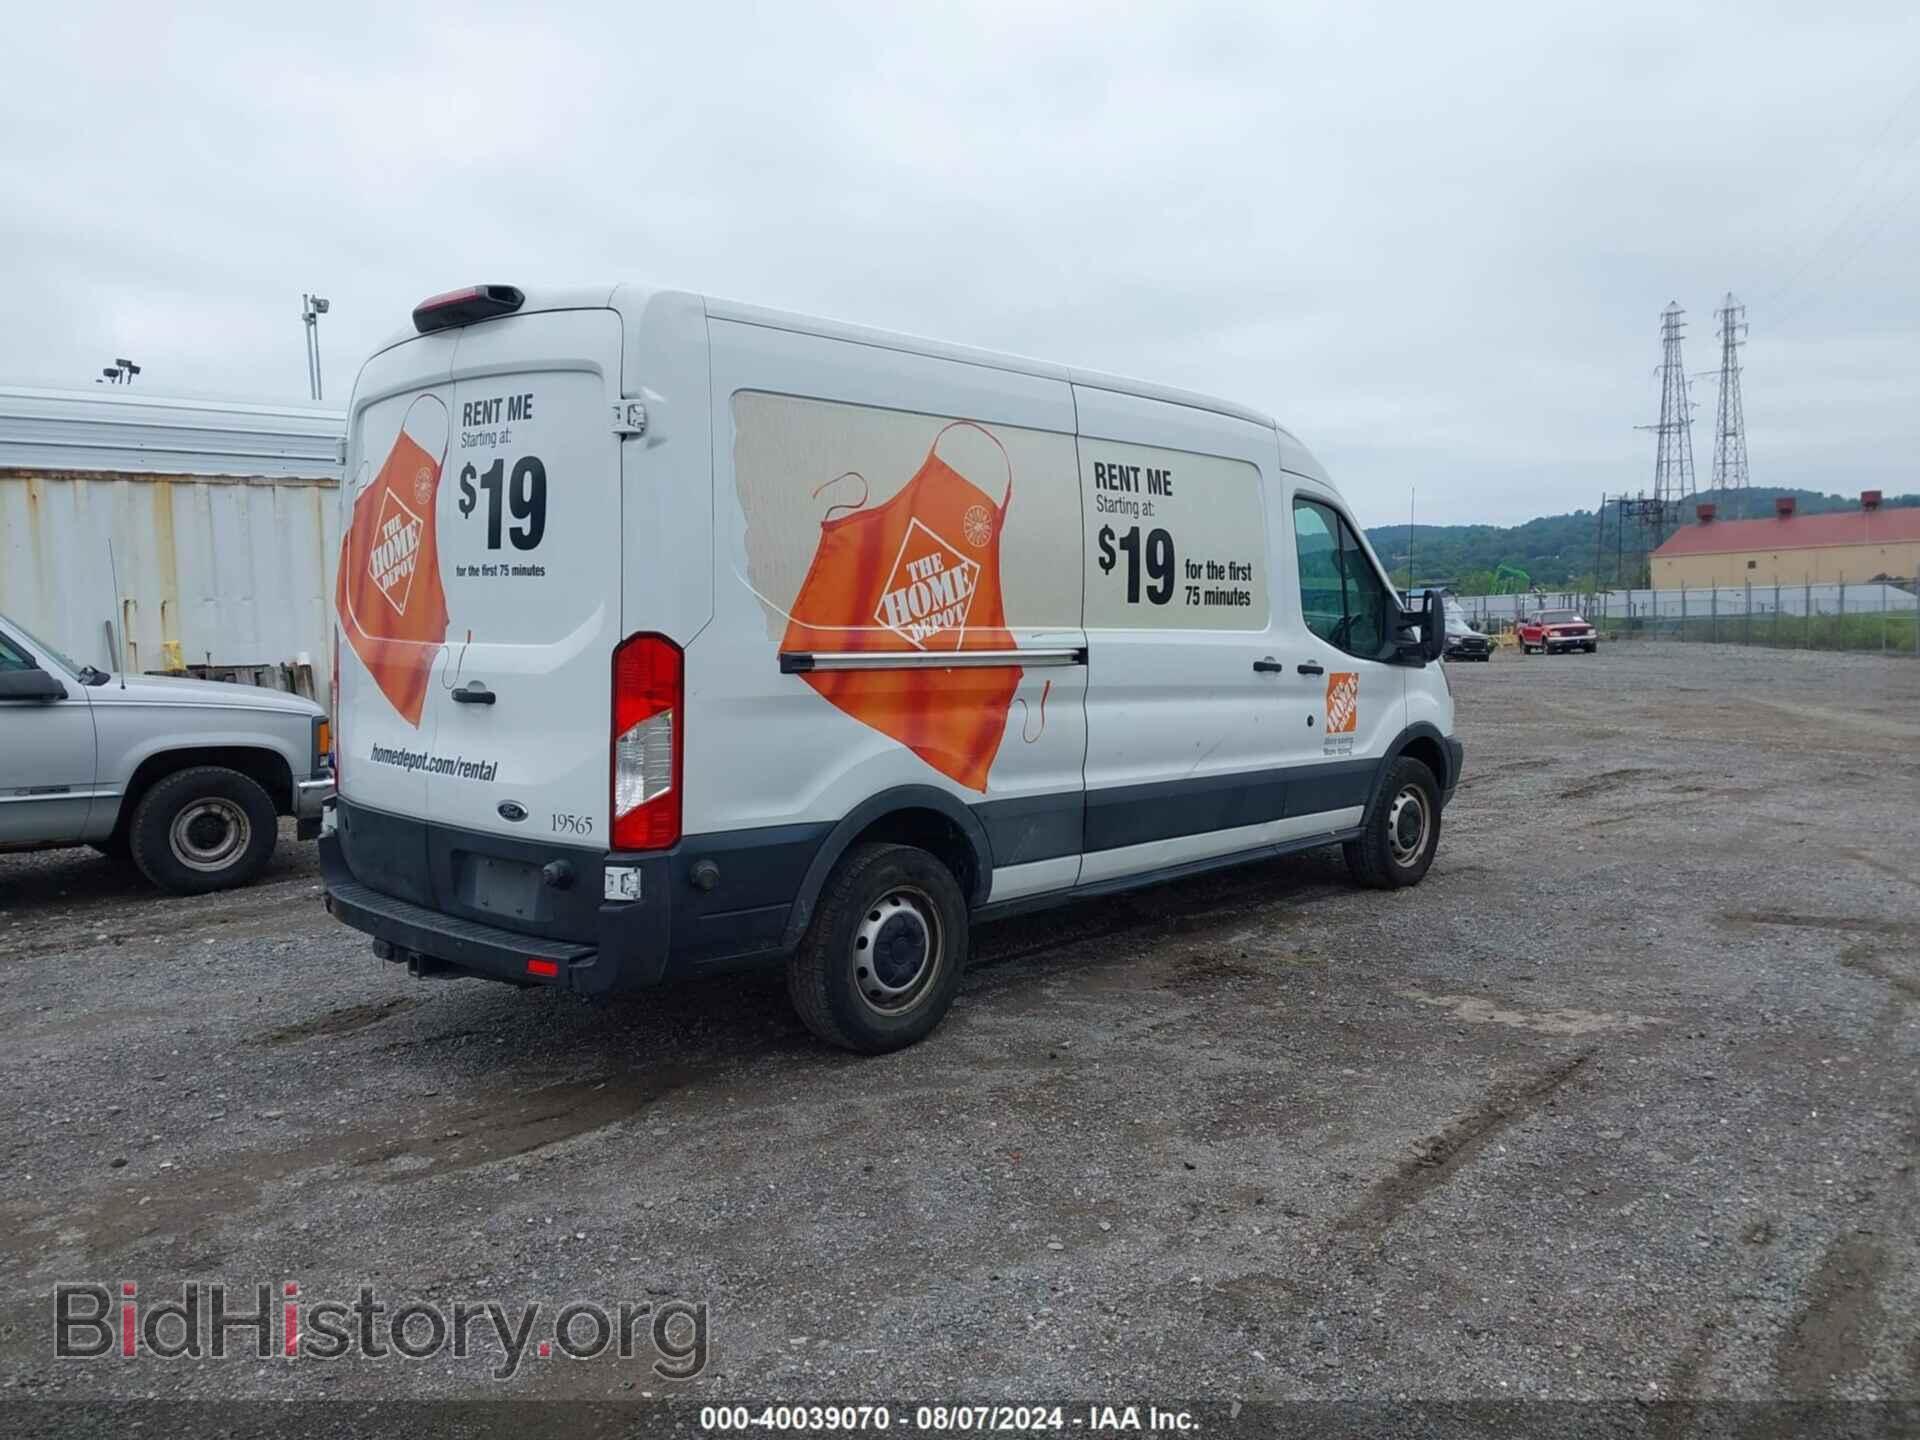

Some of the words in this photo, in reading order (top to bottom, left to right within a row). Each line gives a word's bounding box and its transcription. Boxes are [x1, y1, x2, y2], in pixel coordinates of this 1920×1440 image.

[462, 398, 502, 428] RENT
[507, 393, 534, 422] ME
[460, 429, 497, 449] Starting
[499, 428, 513, 445] at:
[1094, 461, 1140, 493] RENT
[1147, 468, 1173, 496] ME
[458, 456, 547, 551] $19
[1096, 493, 1139, 519] Starting
[1142, 499, 1155, 517] at:
[382, 512, 402, 540] THE
[371, 519, 417, 579] HOME
[1098, 523, 1176, 606] $19
[382, 553, 414, 592] DEPOT
[456, 563, 467, 577] for
[468, 564, 480, 577] the
[481, 563, 498, 577] first
[500, 563, 509, 577] 75
[512, 563, 545, 577] minutes
[905, 552, 945, 582] THE
[1185, 558, 1203, 580] for
[1207, 560, 1225, 581] the
[1228, 561, 1252, 582] first
[884, 560, 973, 628] HOME
[1185, 586, 1200, 606] 75
[1204, 586, 1251, 607] minutes
[907, 602, 965, 643] DEPOT
[370, 742, 498, 782] homedepot.com/rental
[551, 812, 593, 835] 19565
